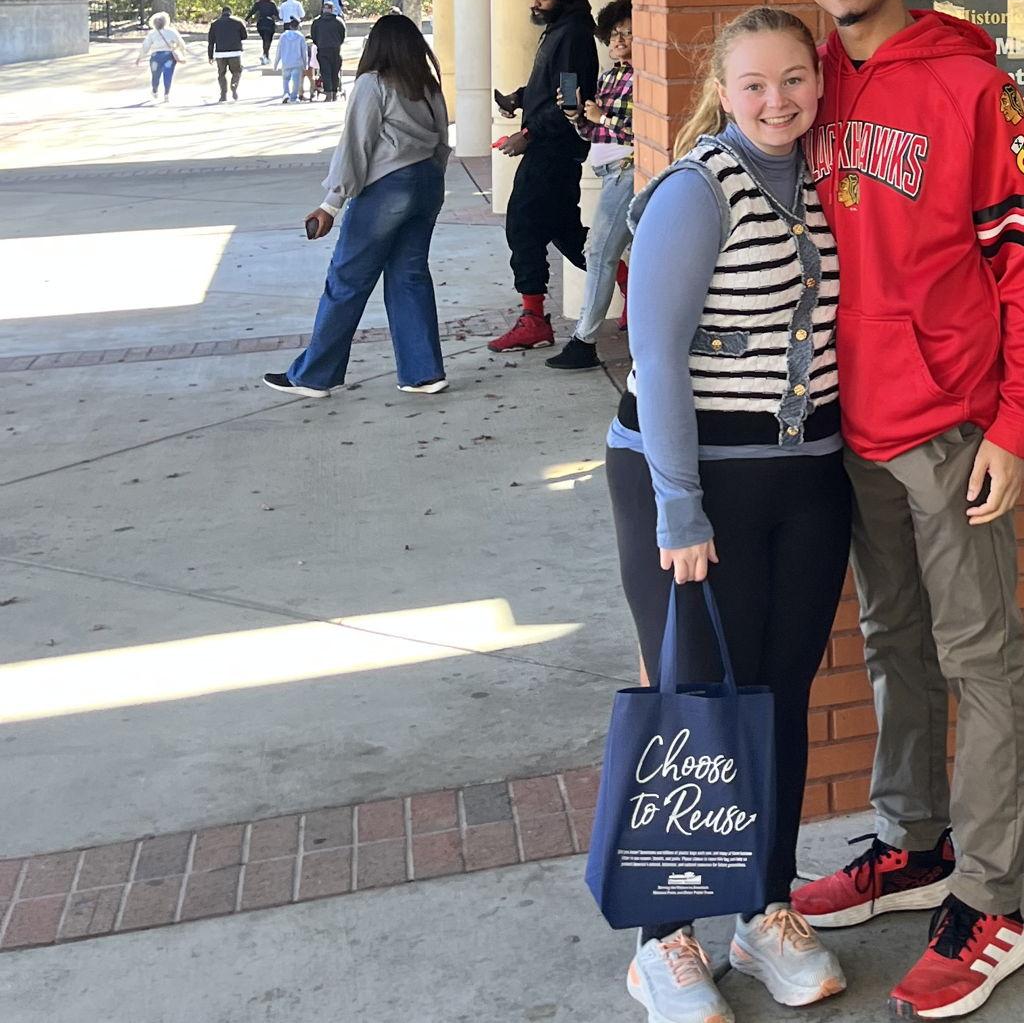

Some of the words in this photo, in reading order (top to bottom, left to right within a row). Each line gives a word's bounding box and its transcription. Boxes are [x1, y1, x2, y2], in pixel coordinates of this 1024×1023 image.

[803, 120, 929, 199] LACKHAWKS
[636, 728, 738, 784] Choose
[629, 792, 660, 829] to
[663, 783, 757, 836] Reuse
